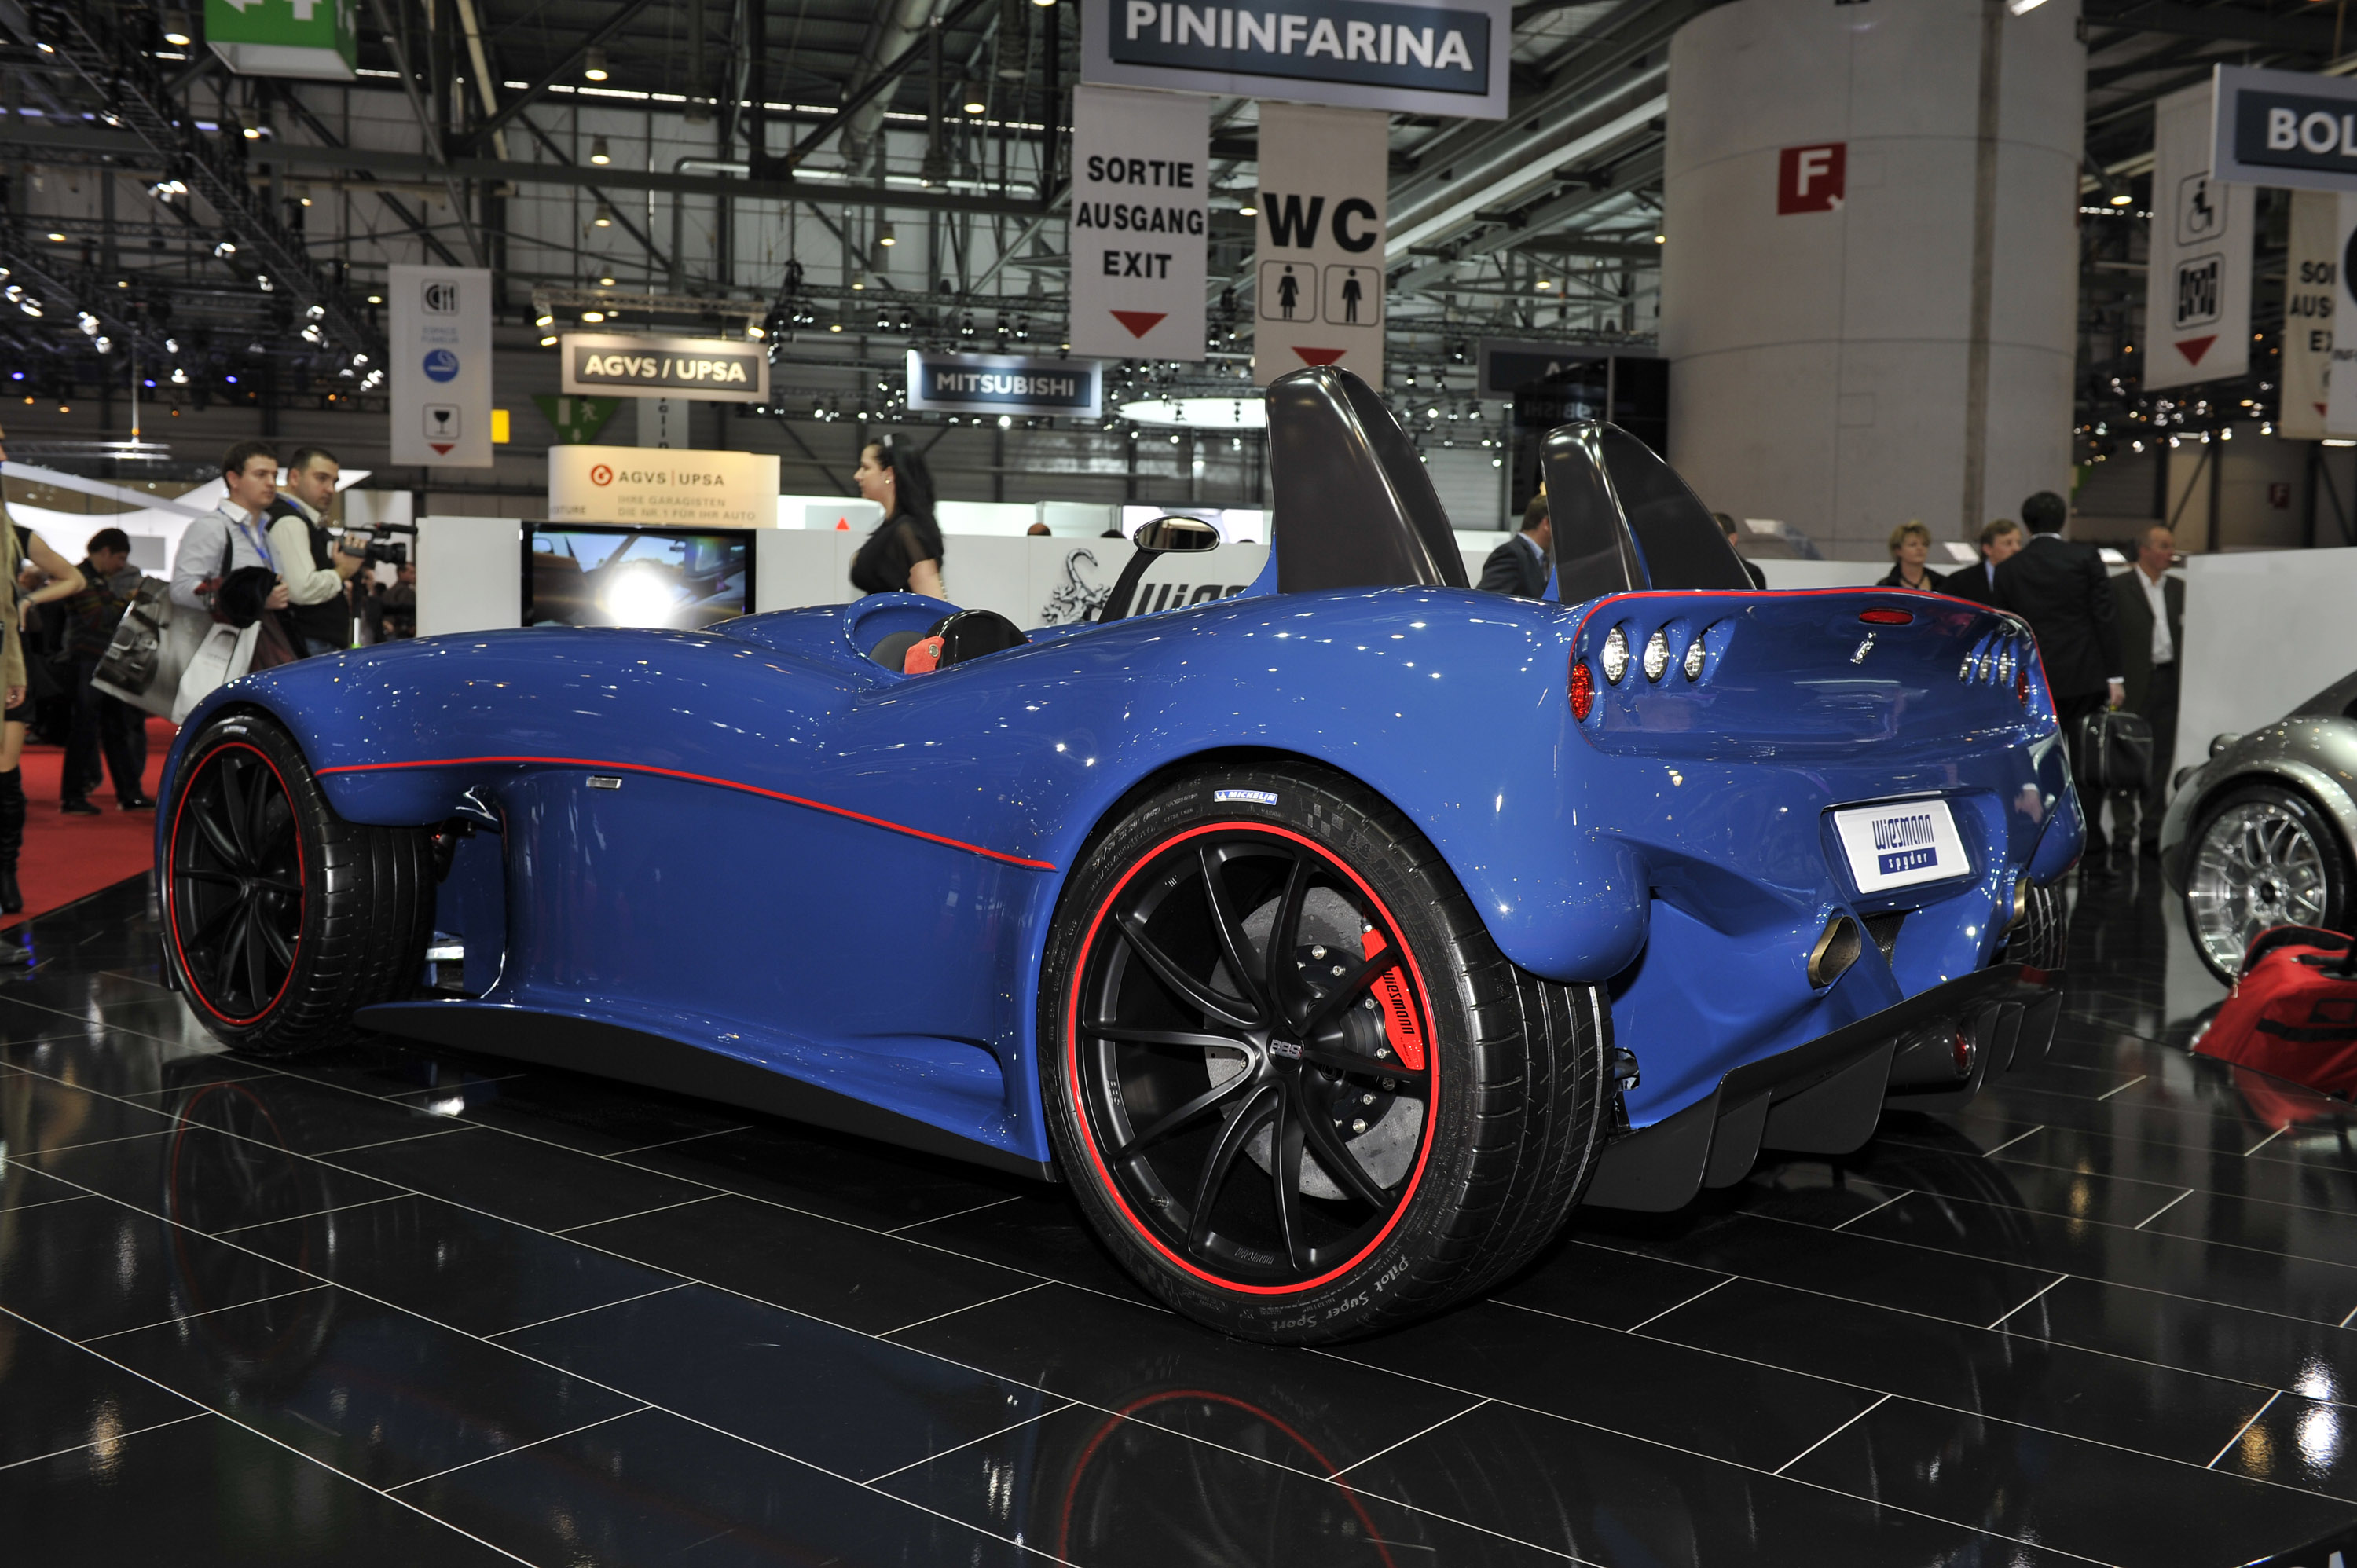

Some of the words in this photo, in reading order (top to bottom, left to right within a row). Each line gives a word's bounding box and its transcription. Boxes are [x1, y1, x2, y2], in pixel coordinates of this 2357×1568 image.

[1126, 0, 1474, 71] PININFARINA
[1087, 155, 1194, 188] SORTIE
[1798, 148, 1832, 196] F
[1076, 201, 1204, 235] AUSGANG
[1262, 192, 1377, 253] WC
[1103, 249, 1173, 279] EXIT
[584, 354, 658, 379] AGVS
[676, 359, 747, 383] UPSA
[936, 372, 1075, 397] MITSUBISHI
[618, 471, 666, 485] AGVS
[679, 473, 725, 486] UPSA
[723, 511, 757, 522] AUTO
[1227, 791, 1276, 802] MICHELIN
[1888, 852, 1927, 871] spyder
[1269, 1039, 1303, 1060] BBS
[1374, 1254, 1409, 1292] Pilot
[1326, 1290, 1369, 1320] Super
[1271, 1315, 1317, 1332] Sport
